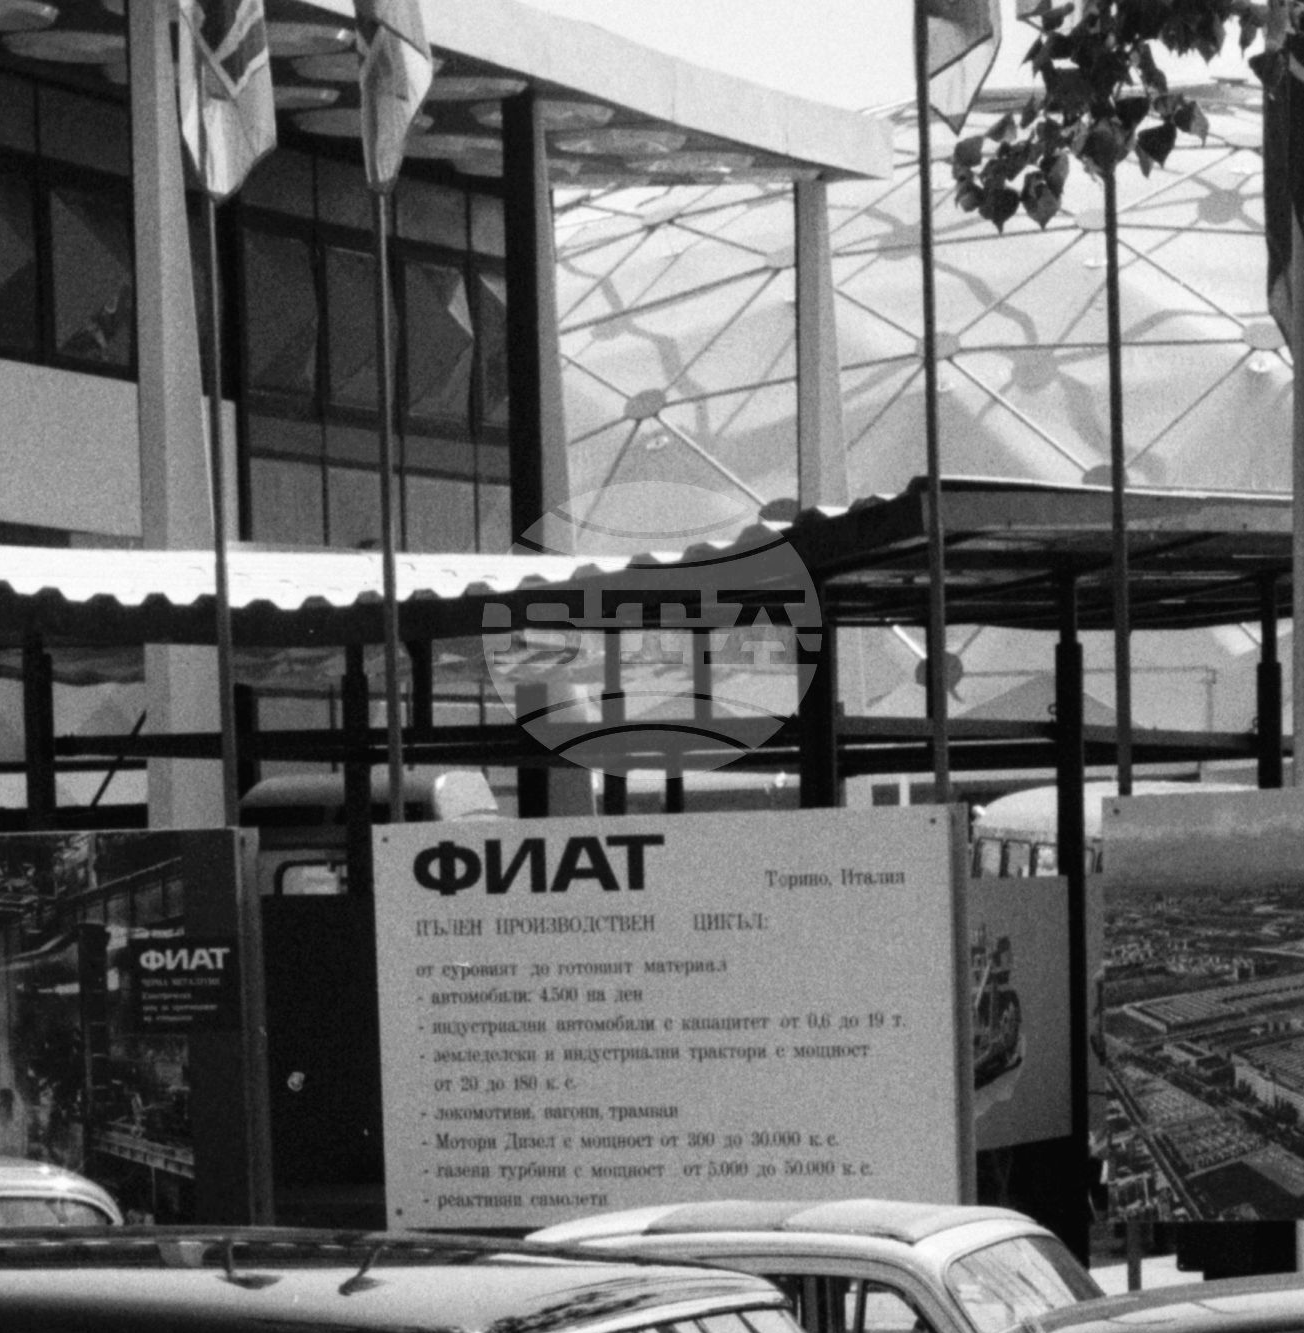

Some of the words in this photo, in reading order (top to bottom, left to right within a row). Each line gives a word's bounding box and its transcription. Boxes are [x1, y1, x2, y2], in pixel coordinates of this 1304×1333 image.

[413, 833, 664, 897] ФИАТ
[841, 868, 905, 886] Италия
[417, 918, 483, 937] ПЪЛЕН
[496, 914, 655, 936] ПРОИЗВОДСТВЕН
[693, 912, 769, 933] ЦИКЪЛ:
[139, 947, 231, 971] ФИАТ
[416, 964, 434, 977] от
[530, 963, 550, 977] до
[644, 960, 727, 977] материал
[587, 989, 606, 1003] на
[614, 989, 643, 1002] ден
[432, 1020, 546, 1038] индустриални
[556, 1014, 655, 1033] автомобили
[663, 1017, 673, 1032] с
[682, 1016, 769, 1032] капацитет
[780, 1015, 799, 1029] от
[839, 1015, 859, 1030] до
[868, 1012, 884, 1028] 19
[545, 1049, 554, 1062] и
[563, 1046, 680, 1064] индустриални
[689, 1046, 767, 1064] трактори
[775, 1046, 785, 1058] с
[794, 1044, 869, 1059] мощност
[434, 1078, 451, 1092] от
[460, 1075, 479, 1092] 20
[485, 1079, 505, 1093] до
[609, 1105, 678, 1122] трамваи
[436, 1132, 496, 1153] Мотори
[504, 1131, 555, 1152] Дизел
[563, 1136, 572, 1149] с
[581, 1134, 653, 1150] мощност
[660, 1134, 678, 1148] от
[724, 1134, 743, 1149] до
[499, 1161, 566, 1182] турбини
[573, 1165, 582, 1179] с
[591, 1164, 664, 1180] мощност
[683, 1163, 702, 1177] от
[756, 1163, 776, 1179] до
[437, 1194, 522, 1212] реактивни
[530, 1193, 608, 1208] самолети
